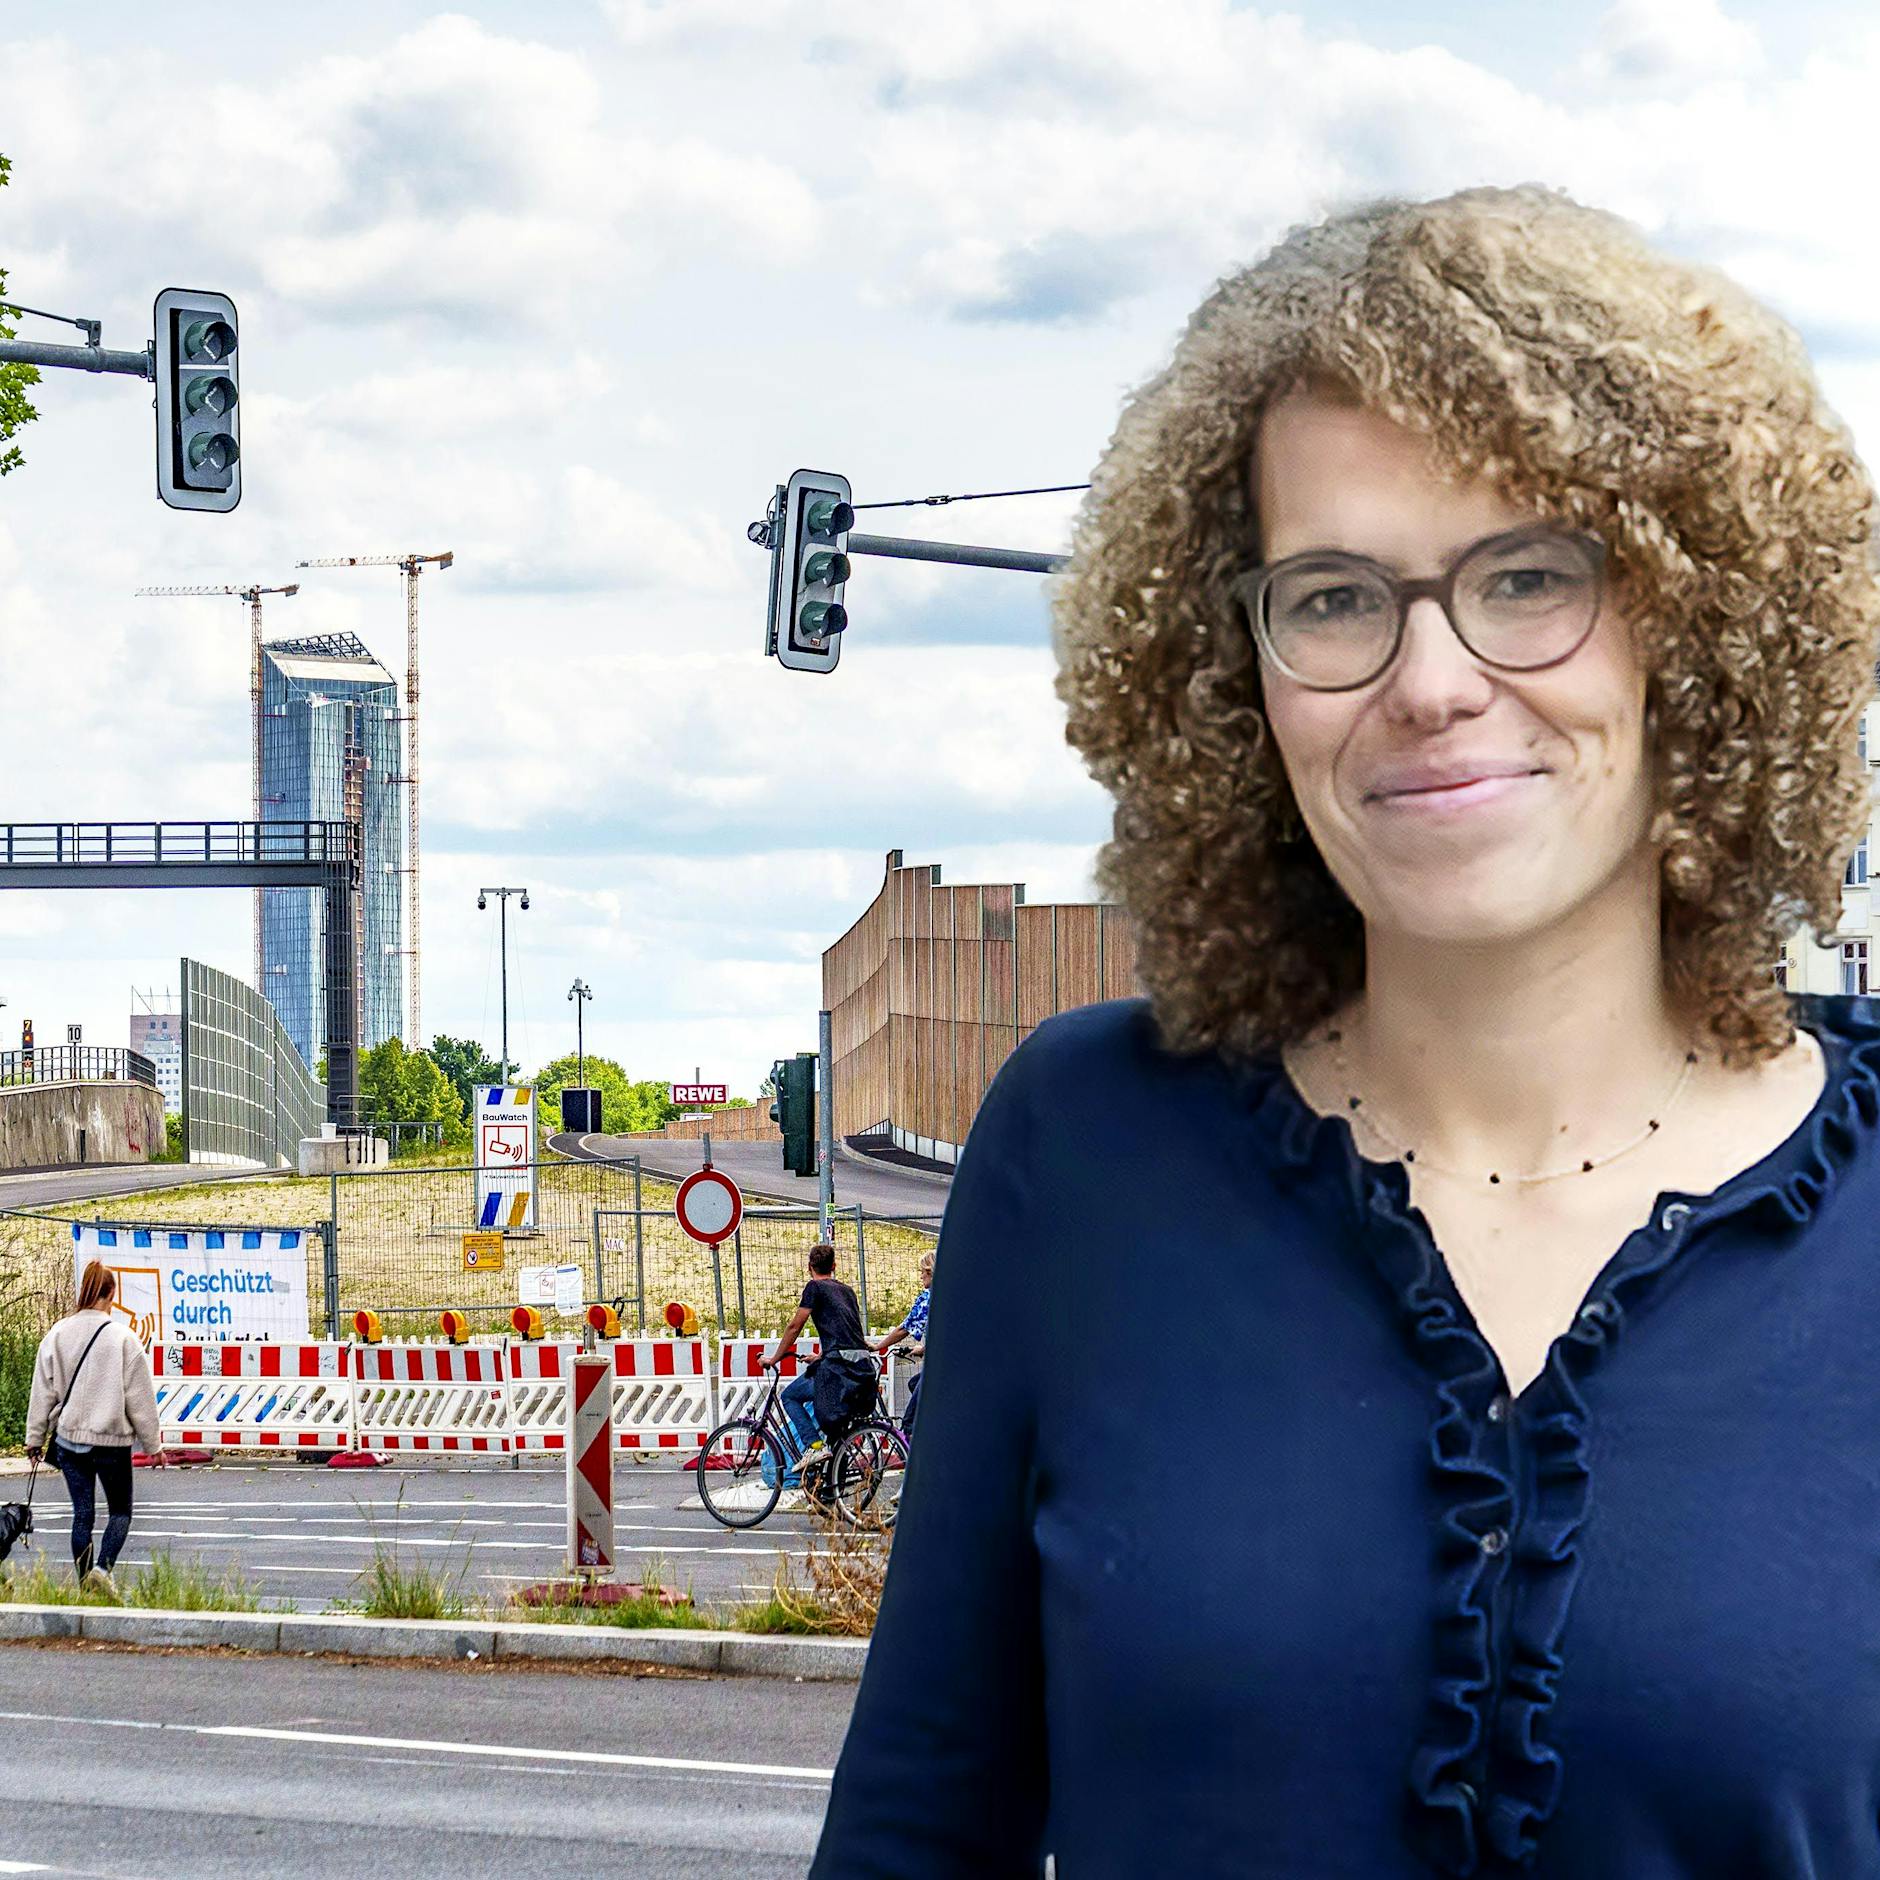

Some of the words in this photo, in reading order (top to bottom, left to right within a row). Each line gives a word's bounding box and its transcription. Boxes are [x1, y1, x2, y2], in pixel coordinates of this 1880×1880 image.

[24, 1021, 31, 1031] 7
[68, 1027, 81, 1041] 10
[675, 1087, 724, 1101] REWE
[482, 1113, 528, 1121] BauWatch
[171, 1268, 273, 1293] Geschützt
[173, 1299, 232, 1324] durch
